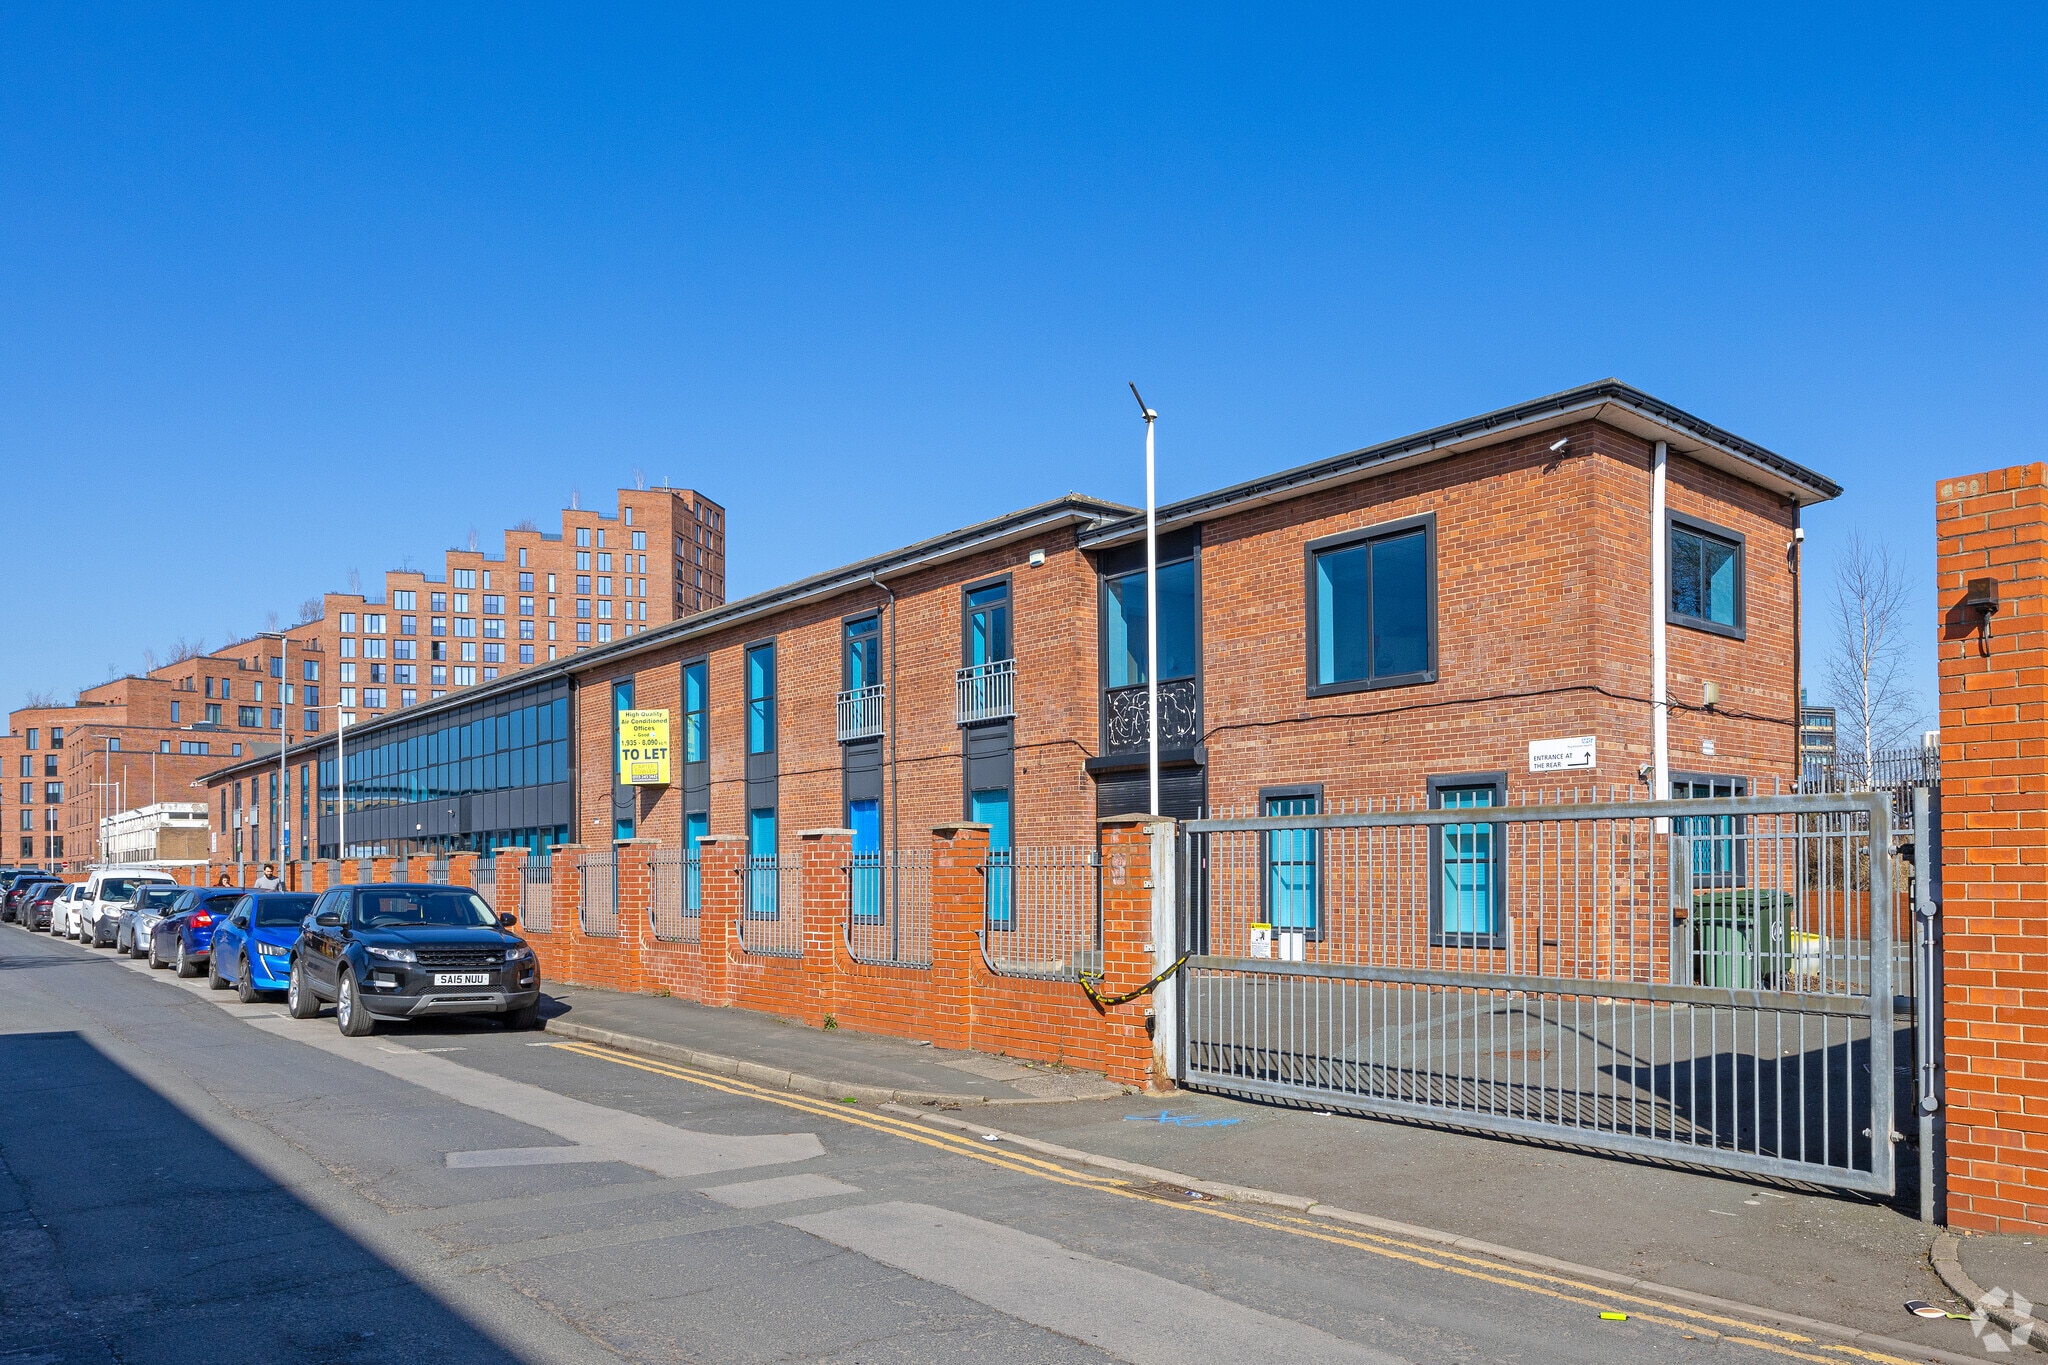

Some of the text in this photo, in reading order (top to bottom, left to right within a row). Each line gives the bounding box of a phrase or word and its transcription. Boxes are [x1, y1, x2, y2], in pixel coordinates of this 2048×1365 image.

[622, 748, 667, 760] TO LET
[1534, 754, 1564, 762] ENTRANCE
[440, 975, 484, 984] SA15 NUU
